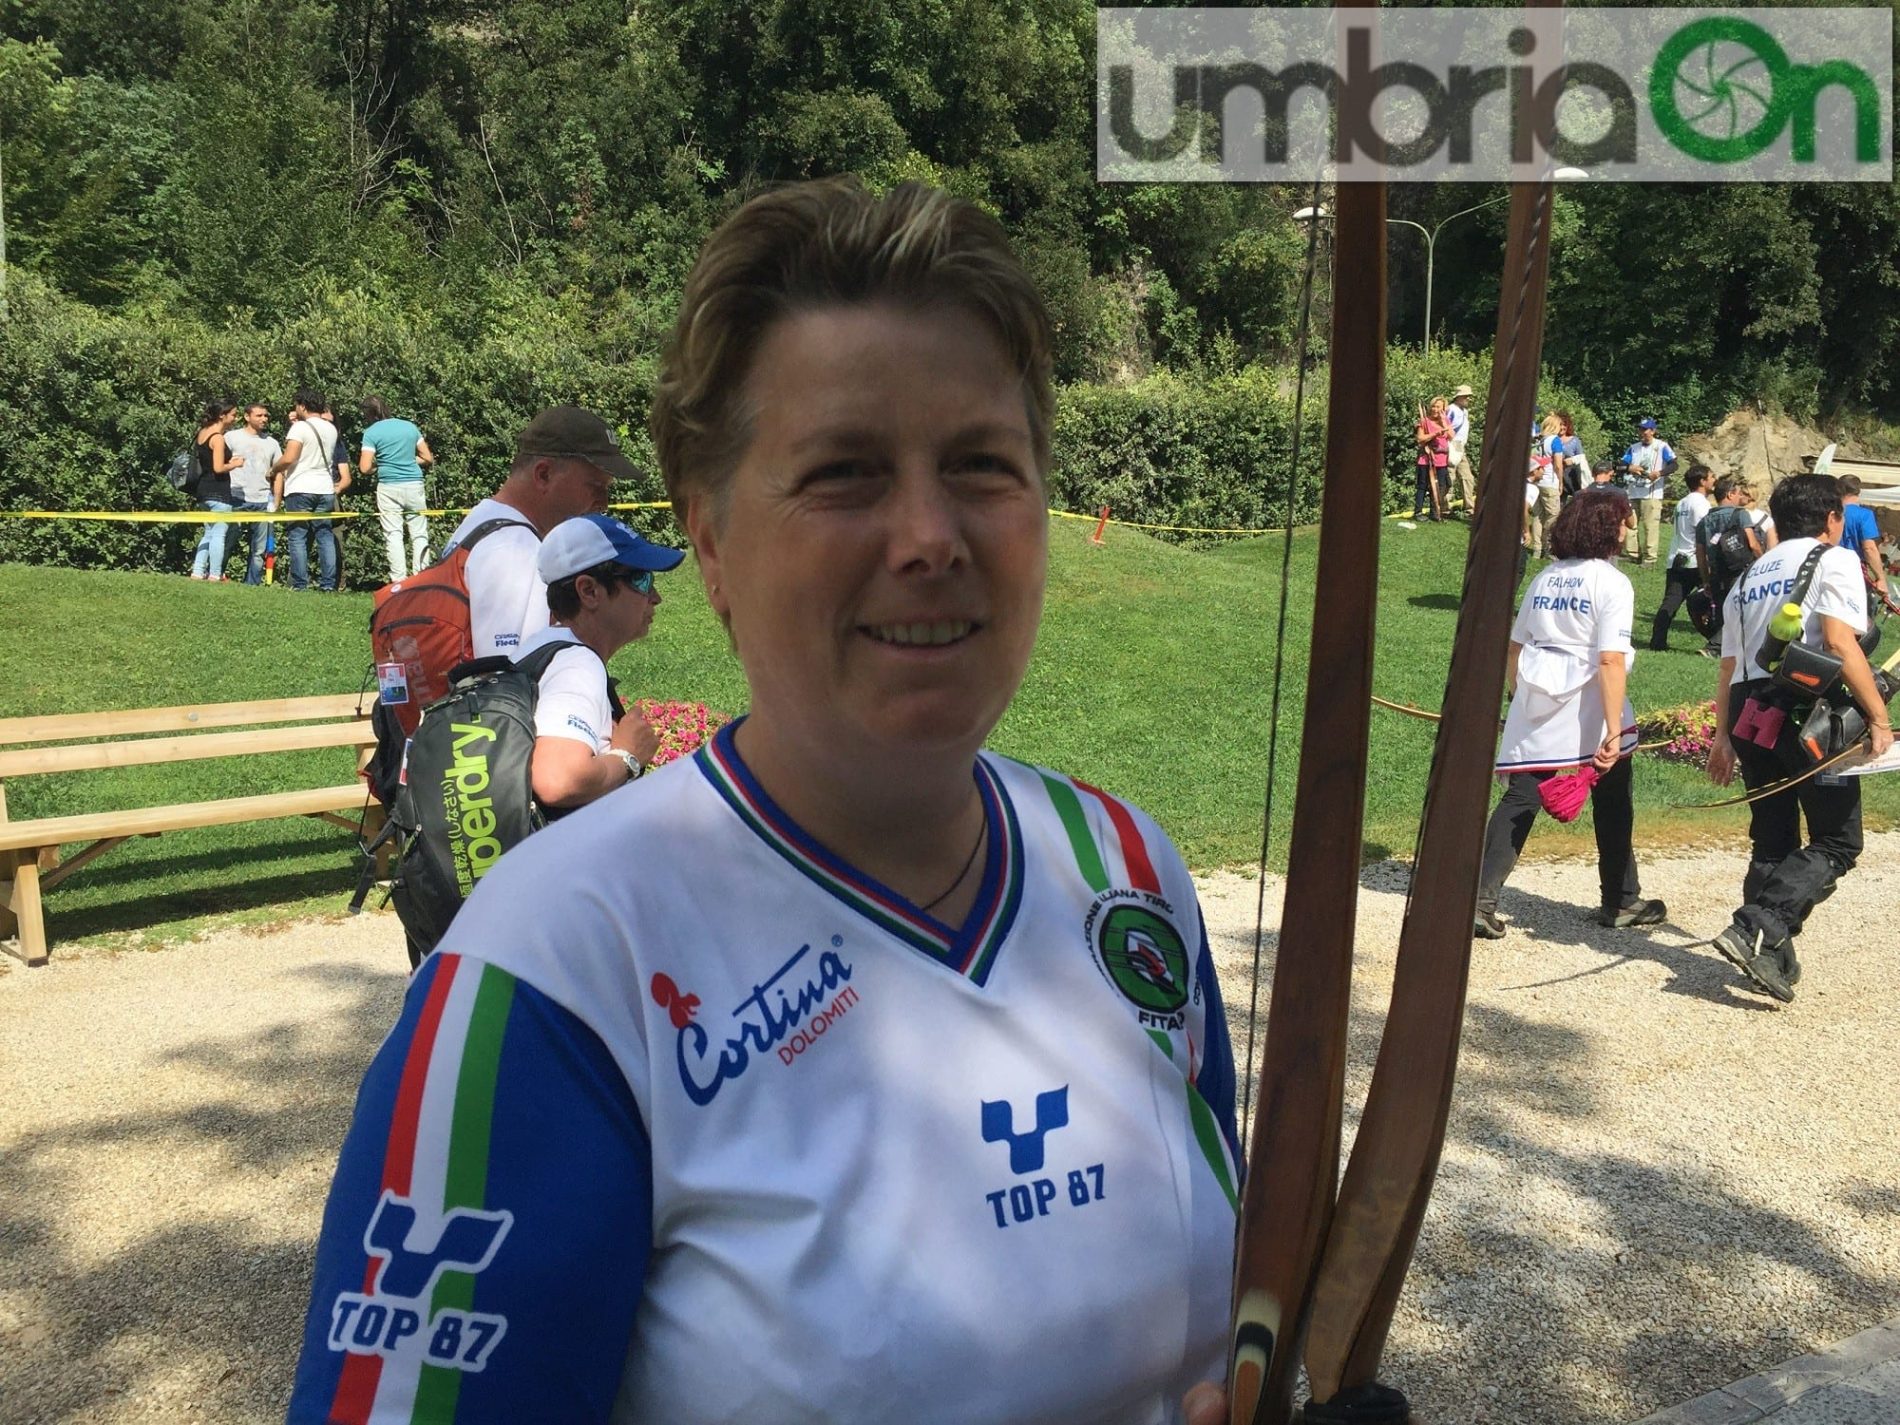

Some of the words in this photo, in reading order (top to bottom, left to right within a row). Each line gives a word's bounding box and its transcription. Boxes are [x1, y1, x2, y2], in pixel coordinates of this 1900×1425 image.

[1532, 596, 1591, 614] FRANCE
[1733, 579, 1797, 610] FRANCE
[677, 943, 852, 1106] Cortina
[777, 986, 860, 1066] DOLOMITI
[986, 1178, 1056, 1228] TOP
[1067, 1163, 1106, 1207] 87
[333, 1300, 419, 1350] TOP
[428, 1315, 499, 1364] 87
